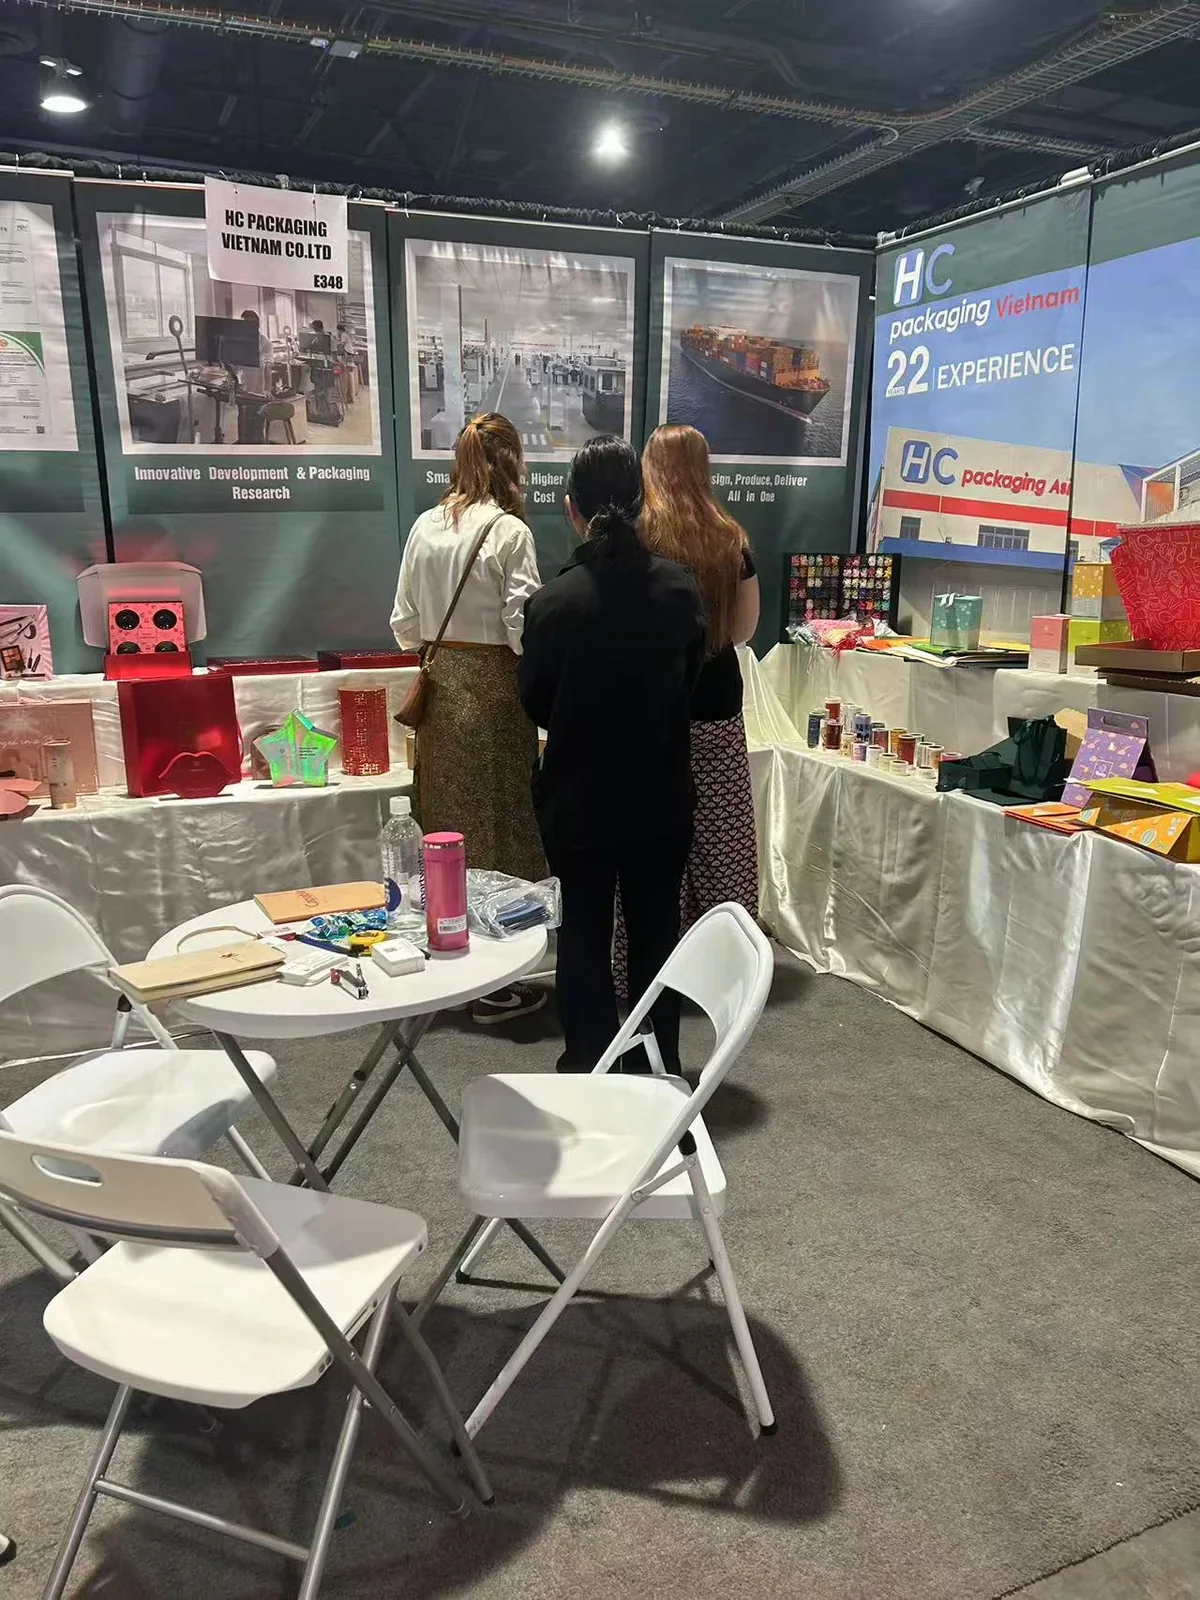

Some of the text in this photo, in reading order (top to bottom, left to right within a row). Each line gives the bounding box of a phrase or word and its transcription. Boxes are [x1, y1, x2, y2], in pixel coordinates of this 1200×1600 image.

[225, 209, 327, 238] HC PACKAGING
[221, 232, 332, 260] VIETNAM CO.LTD
[313, 274, 343, 289] E348
[893, 244, 956, 306] HC
[889, 286, 1080, 345] packaging Vietnam
[885, 343, 1076, 397] 22 EXPERIENCE
[134, 466, 370, 481] Innovative Development & Packaging
[901, 440, 1071, 497] HC packaging Asi
[426, 470, 451, 484] Sma
[531, 472, 564, 487] Higher
[711, 473, 808, 487] sign, Produce, Deliver
[232, 486, 290, 500] Research
[533, 491, 556, 503] Cost
[727, 490, 775, 502] All in One
